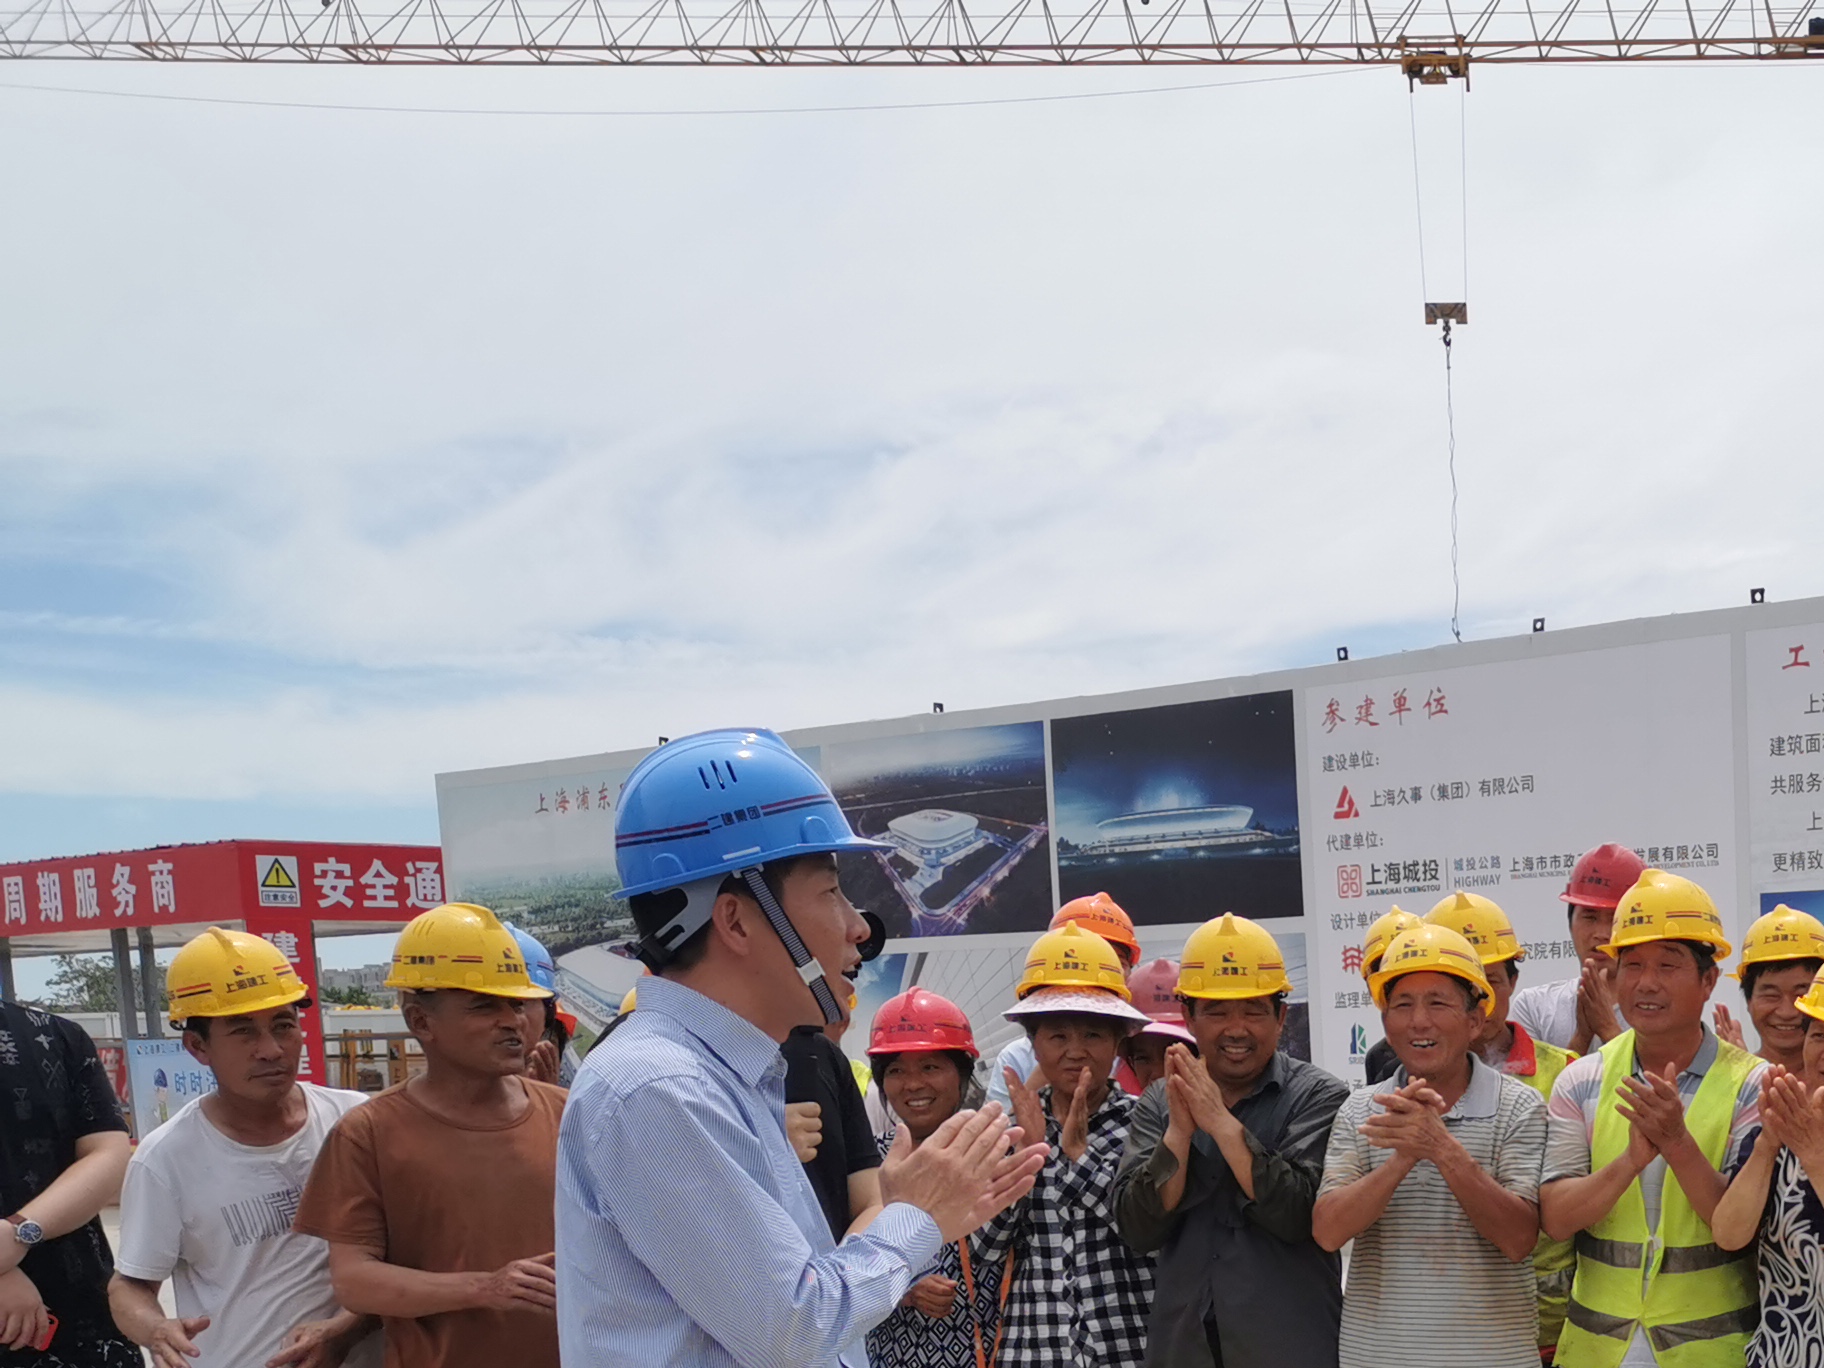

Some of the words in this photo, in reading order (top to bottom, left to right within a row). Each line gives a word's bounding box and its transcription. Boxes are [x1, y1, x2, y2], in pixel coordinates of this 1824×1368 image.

[1321, 686, 1450, 734] 参建单位
[535, 781, 625, 814] 上海浦东
[1370, 775, 1535, 808] 上海久事（集团）有限公司
[313, 857, 445, 908] 安全通
[1366, 859, 1440, 886] 上海城投
[1454, 874, 1501, 888] HIGHWAY
[2, 859, 176, 926] 周期服务商
